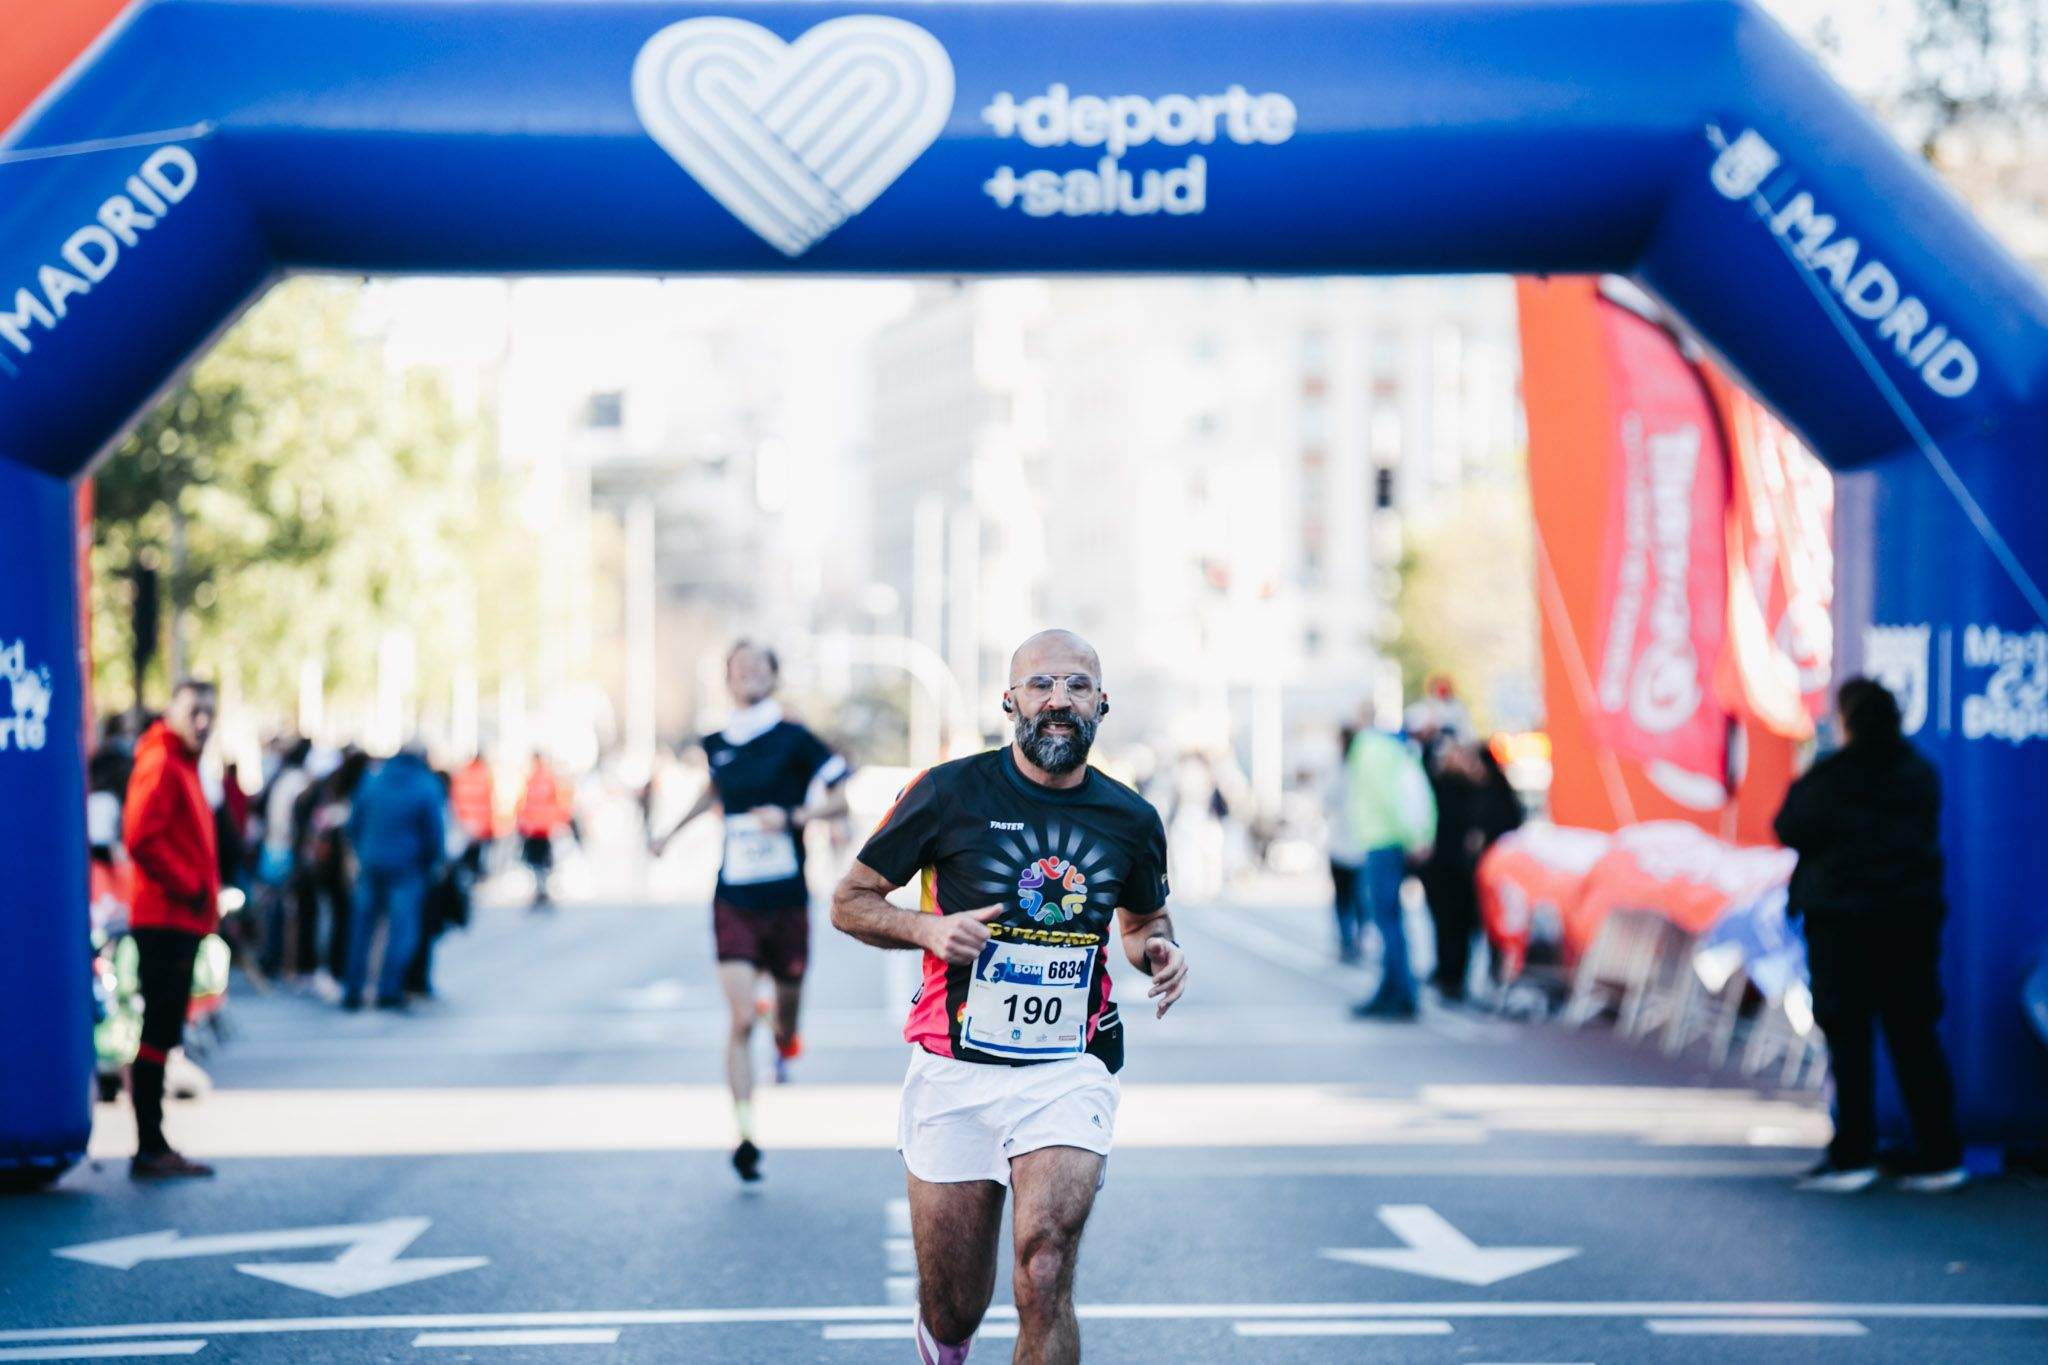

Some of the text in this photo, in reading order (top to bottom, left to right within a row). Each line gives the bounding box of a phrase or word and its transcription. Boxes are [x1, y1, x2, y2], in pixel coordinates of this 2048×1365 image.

[0, 144, 198, 354] MADRID
[1770, 191, 1979, 398] MADRID
[1003, 994, 1062, 1025] 190
